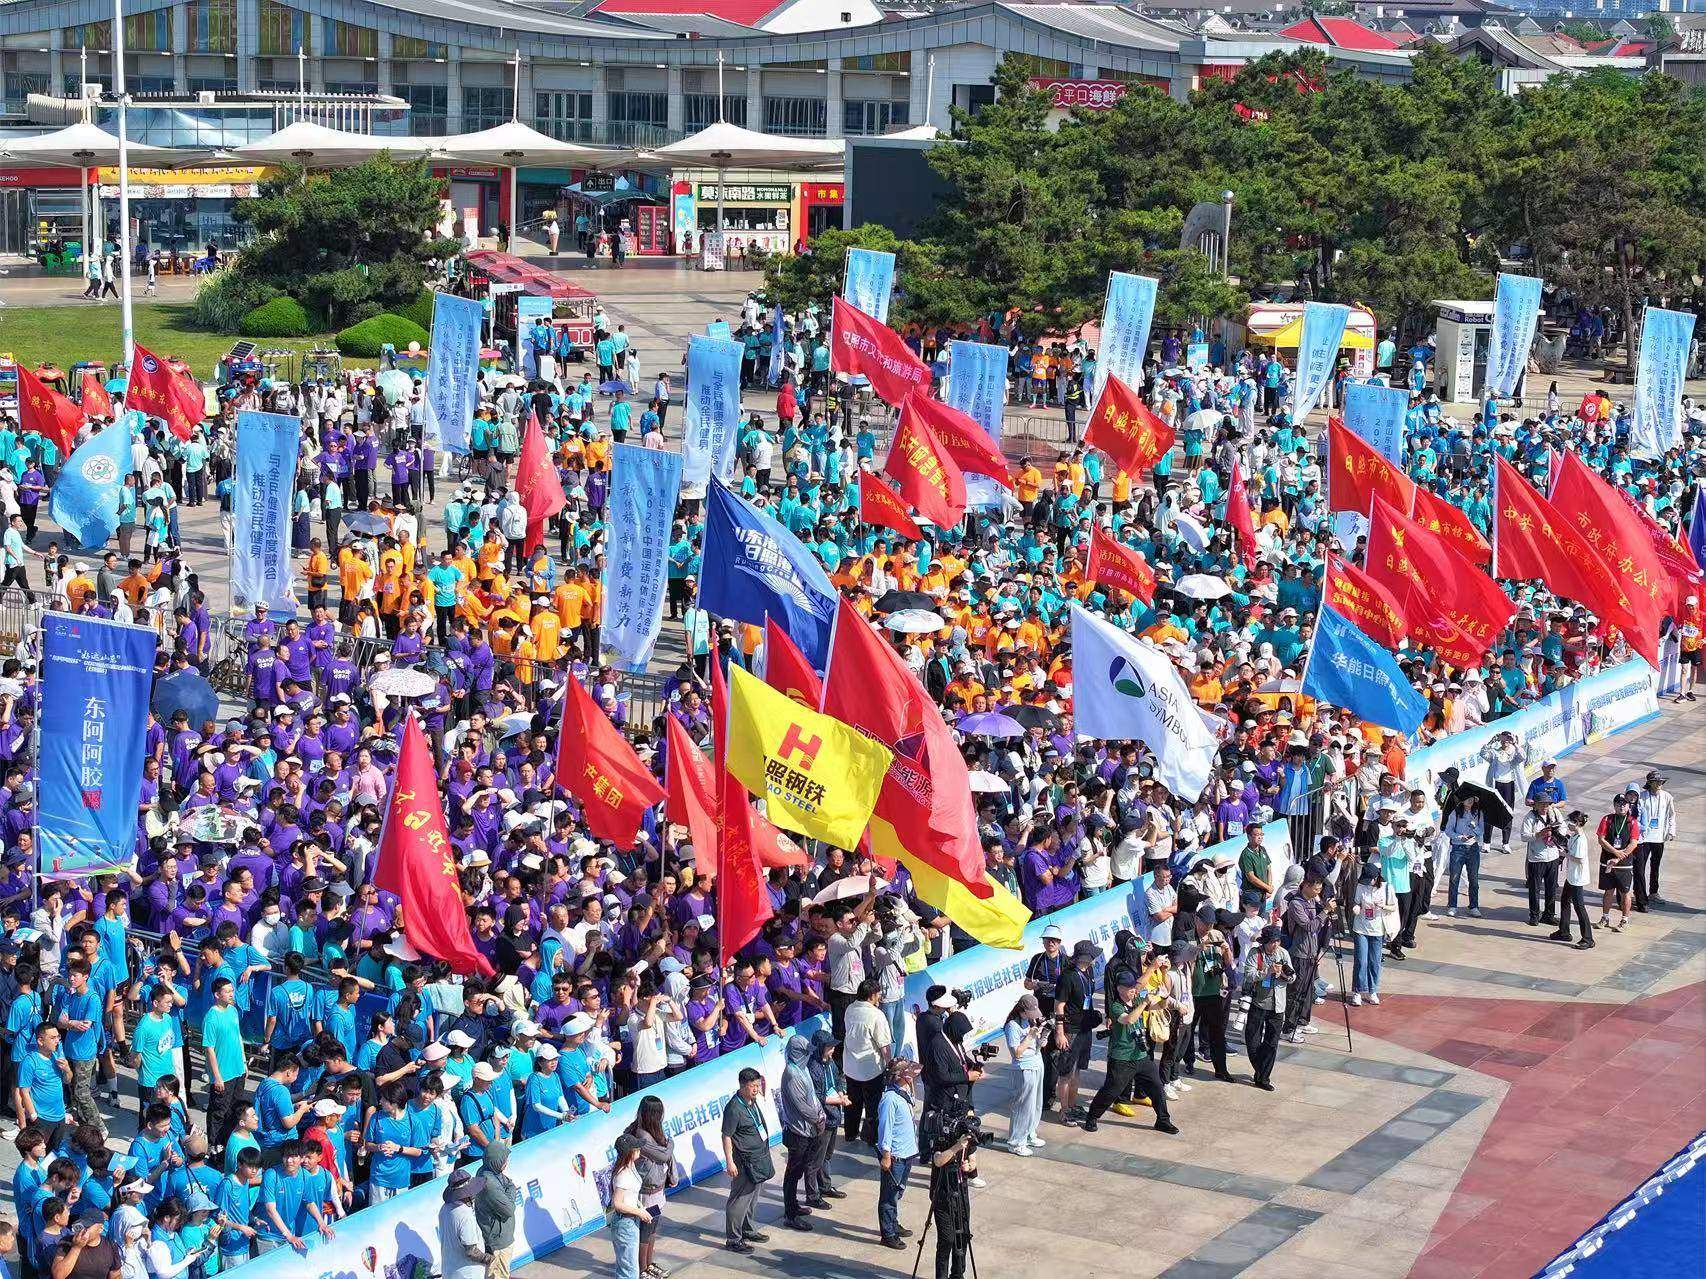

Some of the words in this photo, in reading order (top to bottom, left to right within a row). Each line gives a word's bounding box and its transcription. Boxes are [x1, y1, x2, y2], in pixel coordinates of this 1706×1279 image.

[597, 178, 613, 186] 出口
[817, 189, 838, 199] 市集
[250, 472, 266, 560] 推动全民健身
[264, 453, 281, 580] 与全民健康深度融合
[81, 696, 106, 788] 东阿阿胶
[783, 791, 817, 815] STEEL
